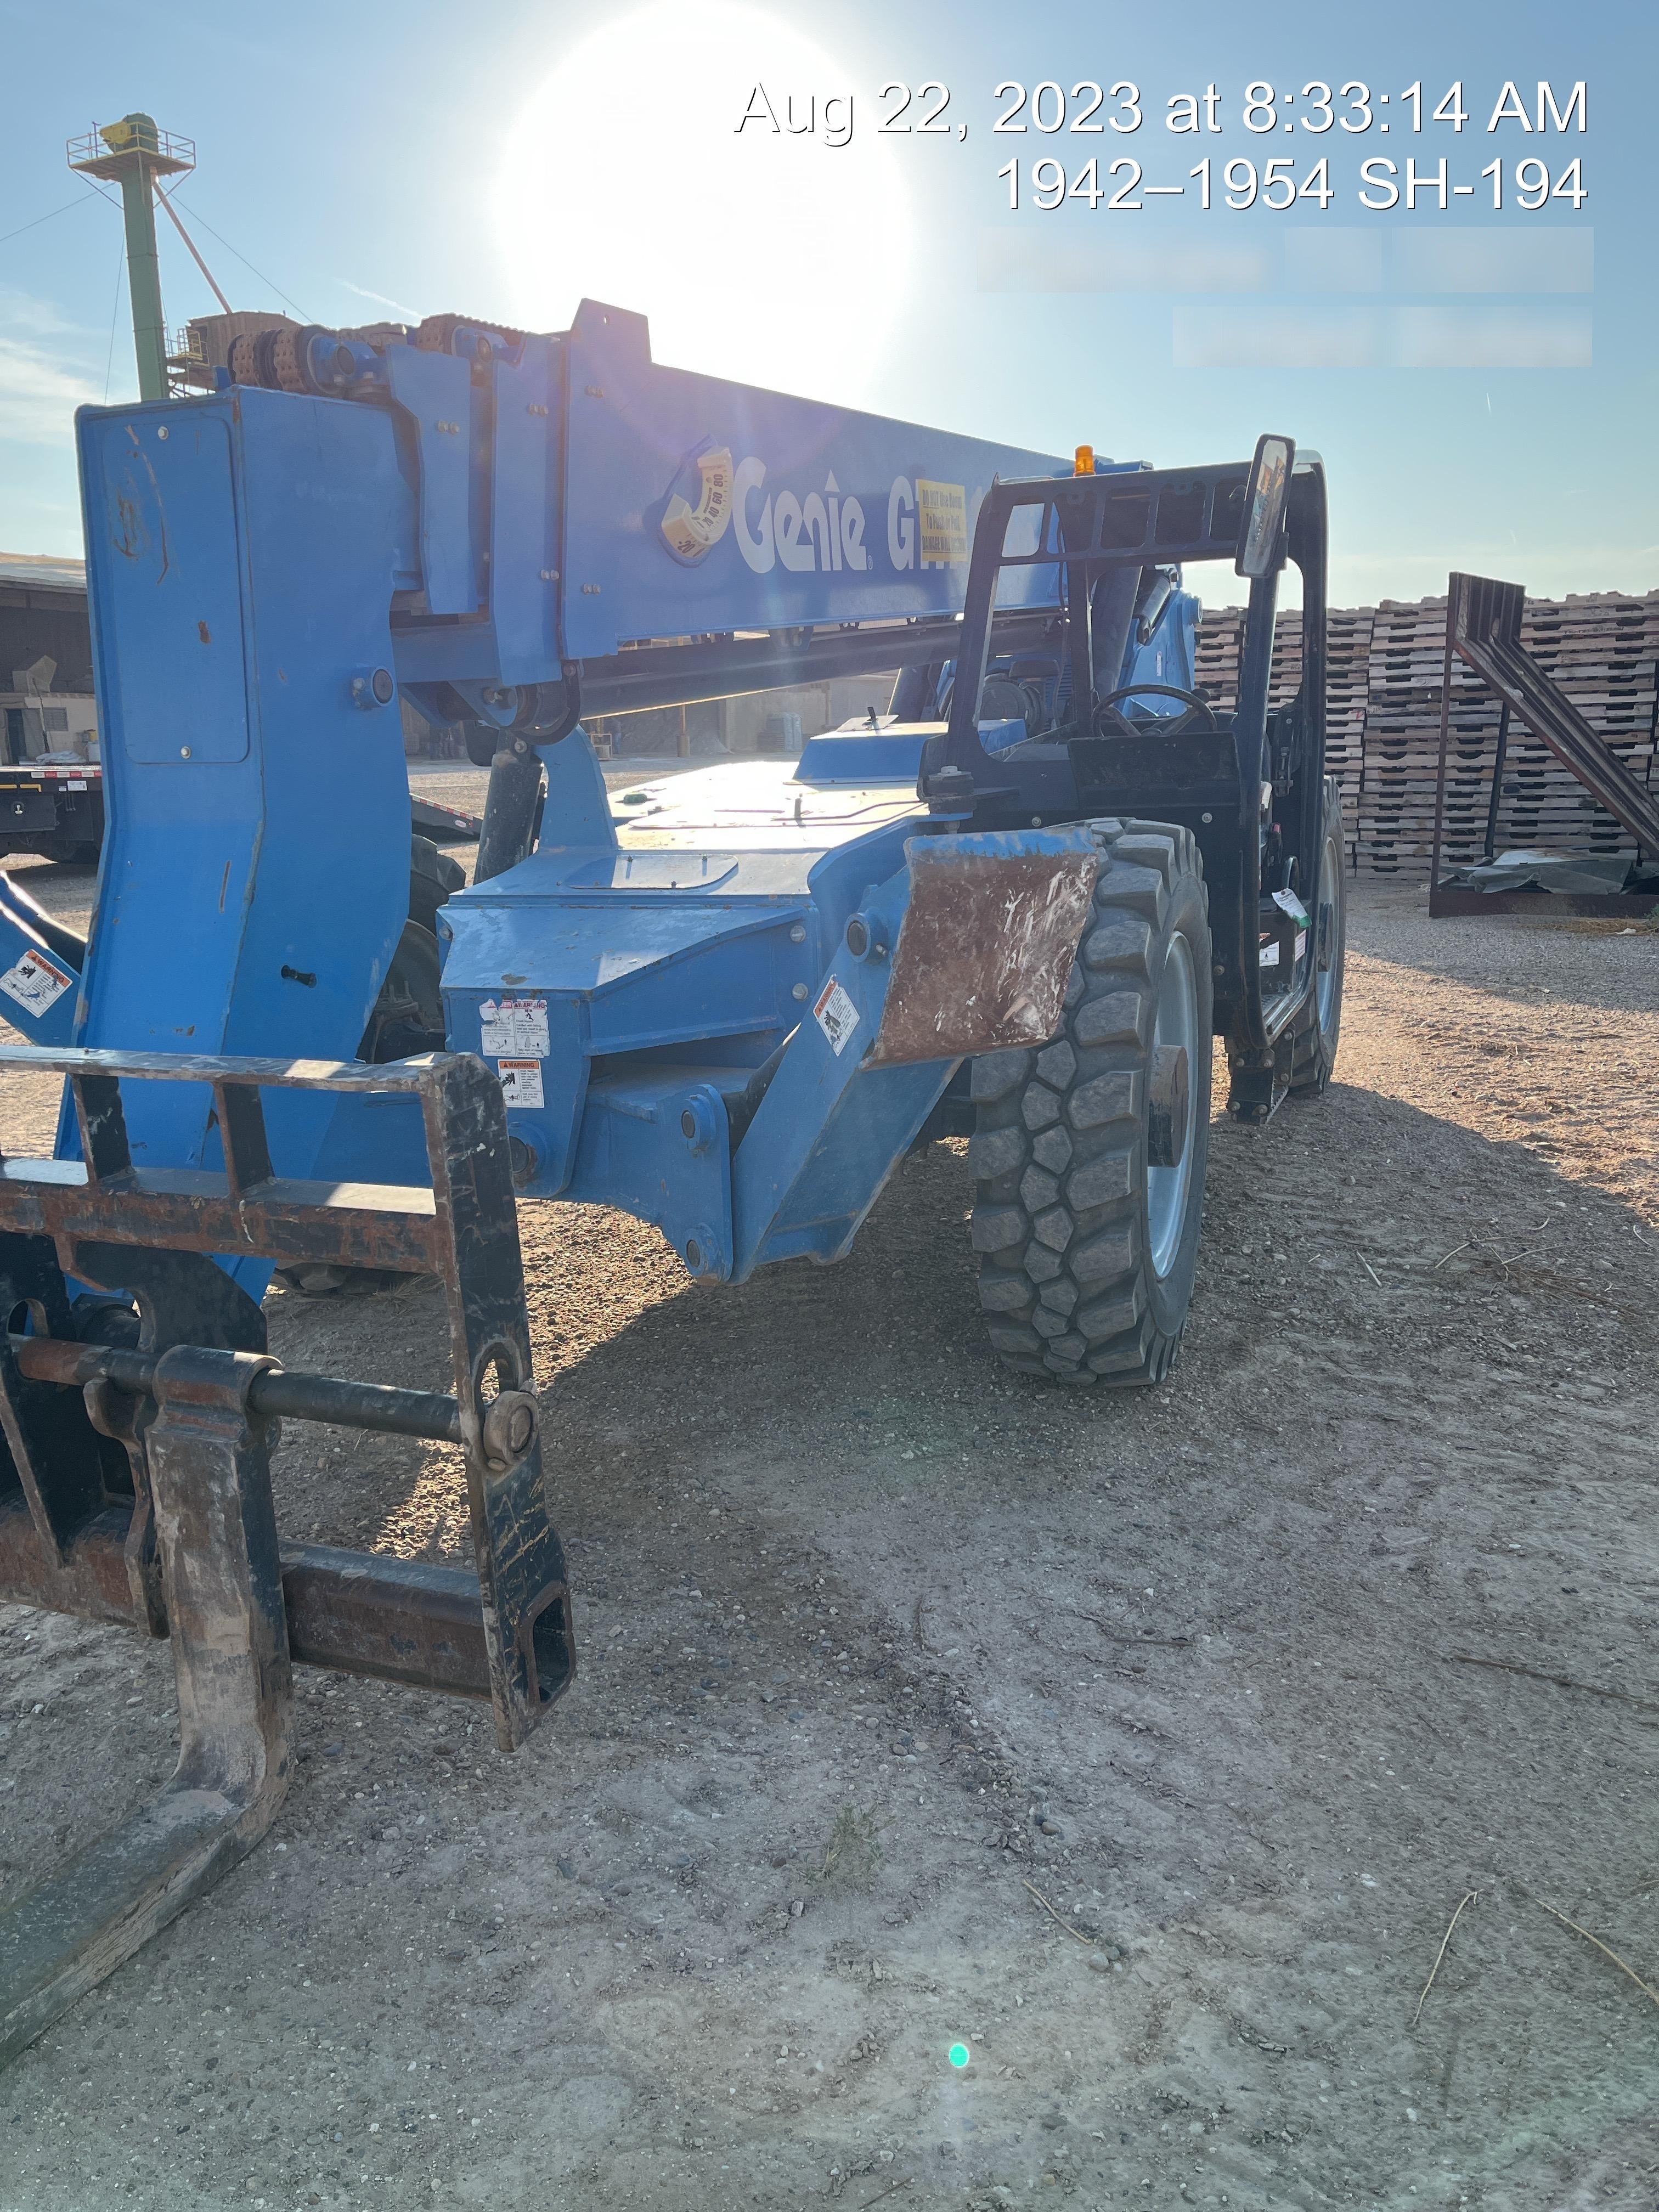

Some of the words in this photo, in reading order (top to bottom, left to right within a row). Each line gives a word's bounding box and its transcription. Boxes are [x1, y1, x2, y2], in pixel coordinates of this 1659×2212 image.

[713, 474, 724, 487] 80
[713, 492, 723, 505] 60
[922, 489, 929, 505] DO
[929, 490, 939, 506] NOT
[940, 491, 949, 507] Use
[708, 506, 719, 518] 40
[733, 456, 867, 574] Genie
[926, 513, 932, 529] To
[922, 535, 940, 551] DAMAGE
